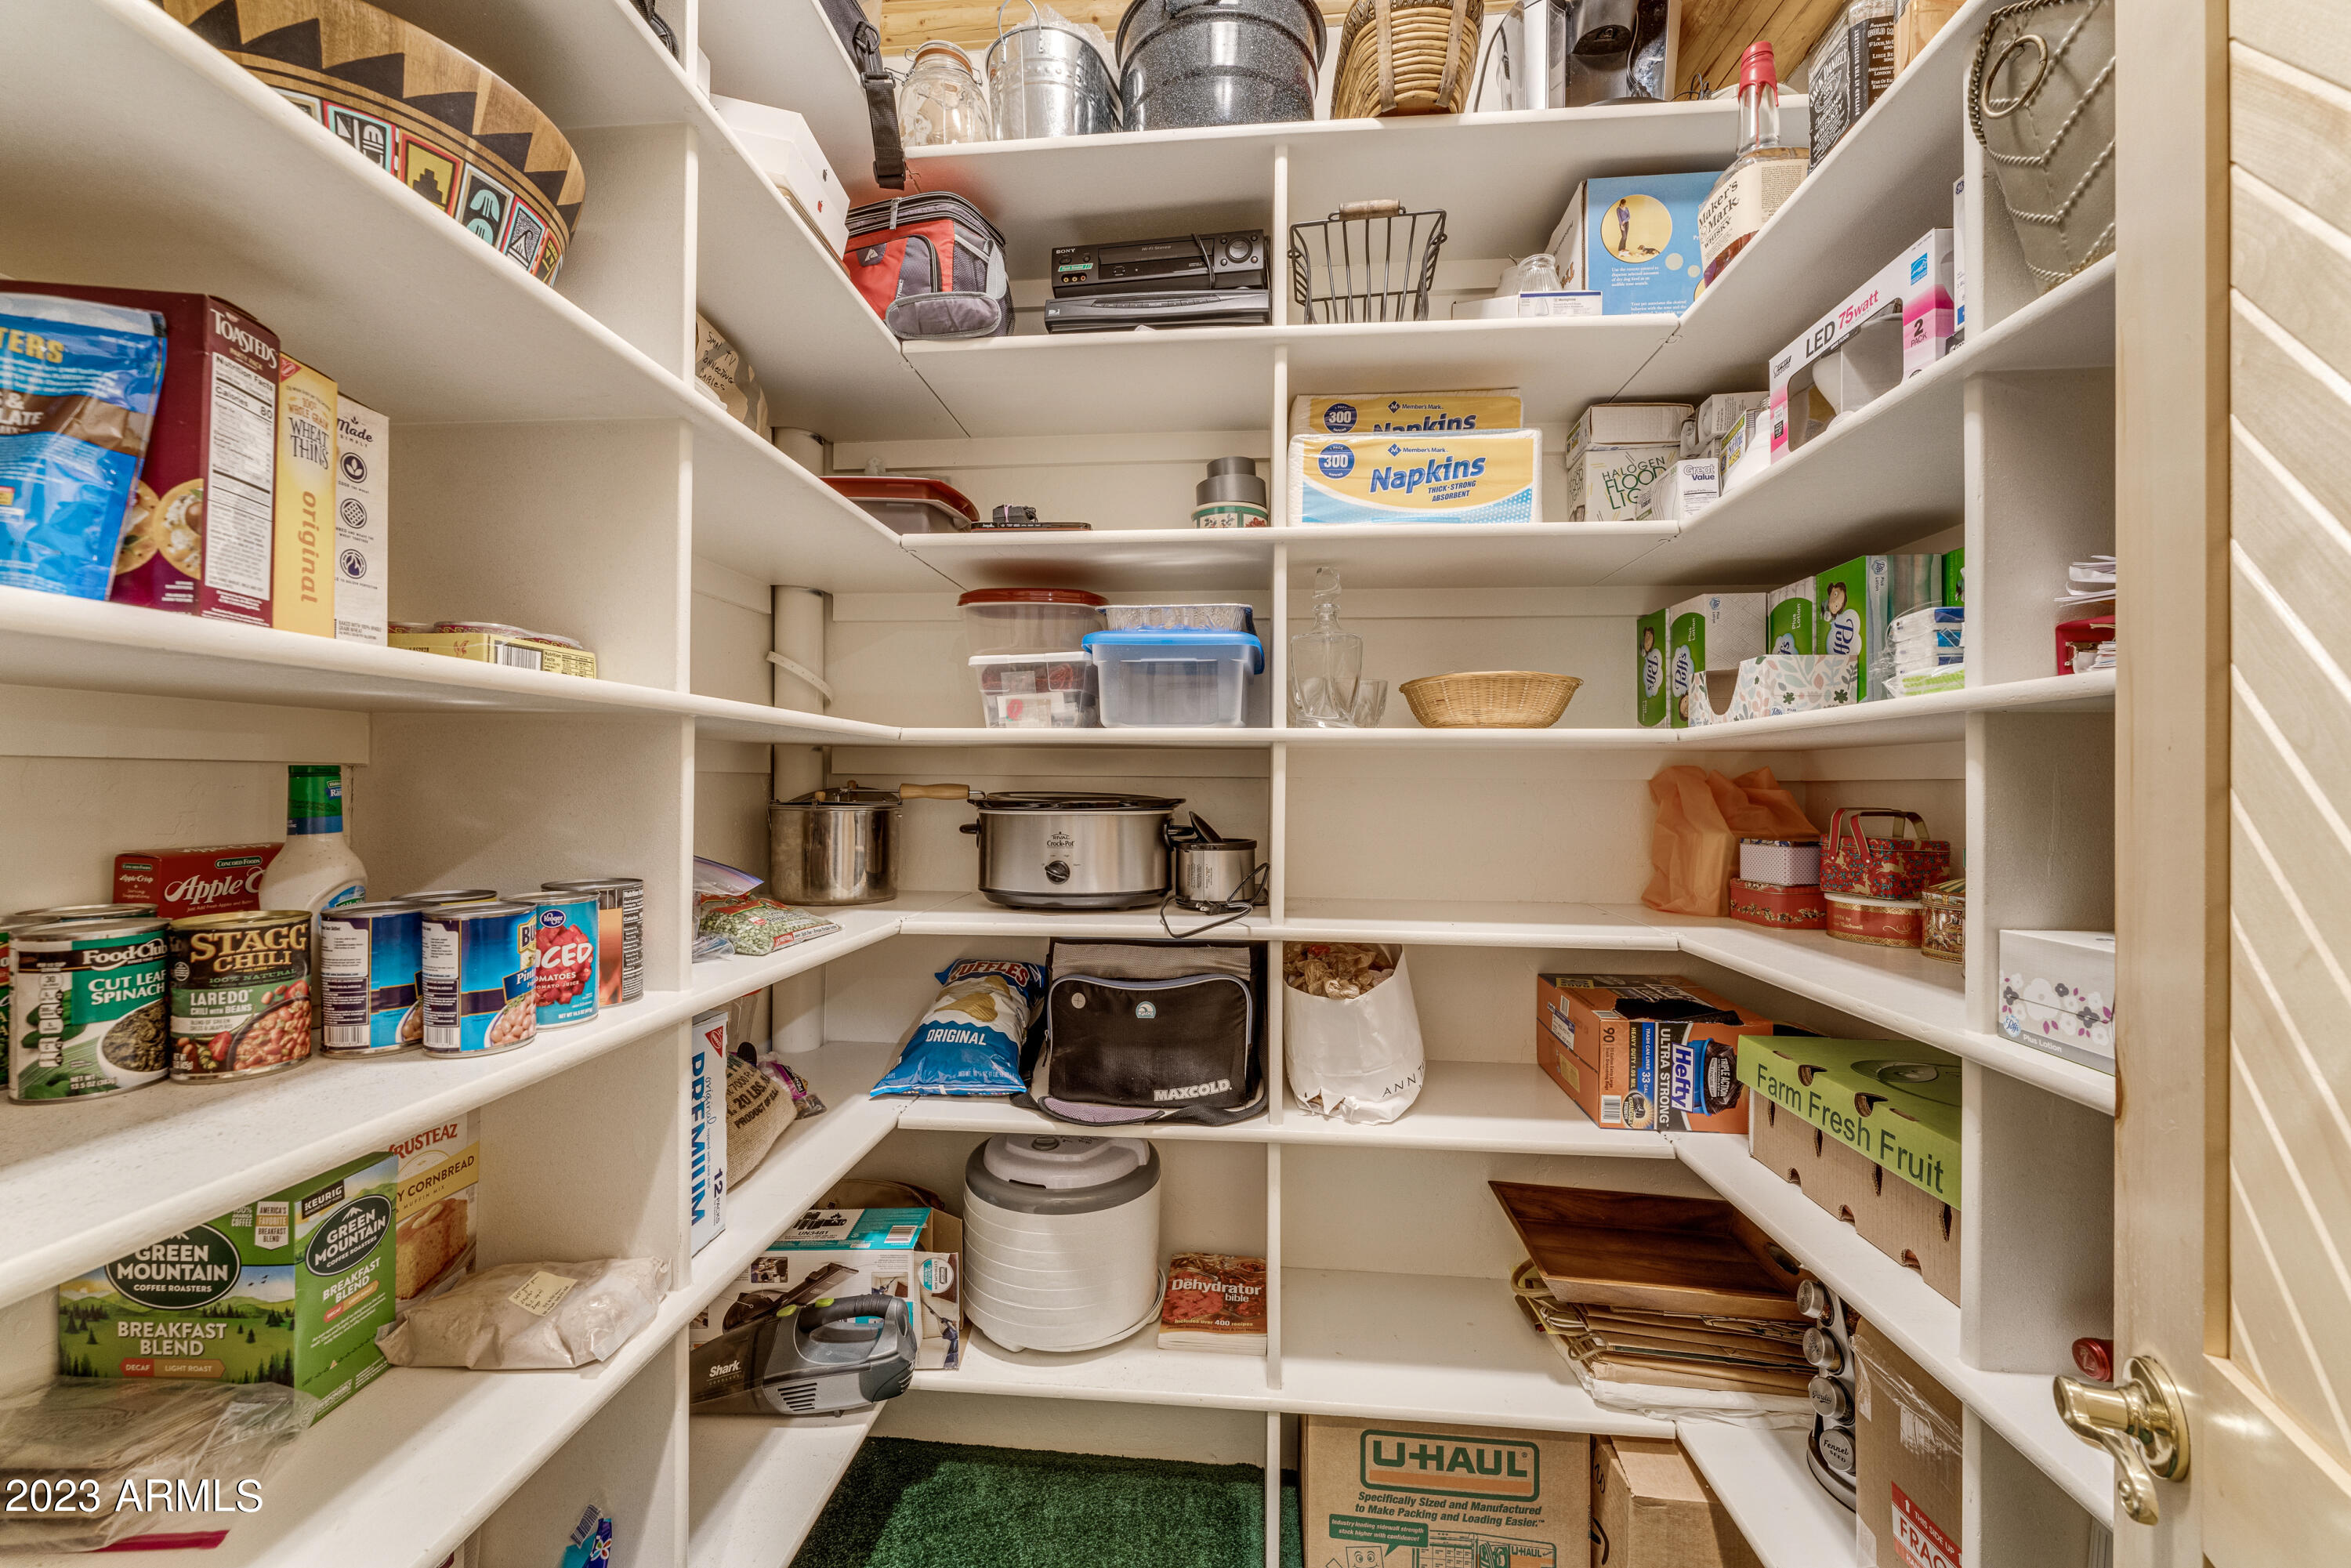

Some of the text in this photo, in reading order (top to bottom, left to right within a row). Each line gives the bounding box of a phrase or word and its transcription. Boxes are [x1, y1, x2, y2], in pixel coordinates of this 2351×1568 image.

[1867, 28, 1885, 38] GOLD
[1814, 100, 1843, 143] WHISKEY
[1699, 181, 1738, 230] Maker's
[1708, 197, 1739, 234] Mark
[1704, 216, 1732, 248] WHISKY
[1913, 317, 1924, 337] 2
[210, 308, 278, 369] TOASTEDS
[1806, 321, 1835, 359] LED
[1911, 331, 1928, 347] PACK
[216, 386, 249, 407] Calories
[1401, 402, 1427, 411] Member's
[260, 405, 273, 419] 80
[1328, 411, 1351, 423] 300
[1373, 413, 1476, 432] Napkins
[288, 417, 330, 448] WHEAT
[337, 418, 374, 443] Made
[1324, 456, 1349, 469] 300
[1603, 457, 1665, 480] HALOGEN
[1684, 465, 1715, 475] Great
[1369, 456, 1487, 494] Napkins
[1692, 473, 1715, 481] Value
[1428, 480, 1476, 494] THICK STRONG
[1432, 491, 1470, 502] ABSORBENT
[297, 491, 320, 603] original
[1646, 655, 1659, 690] Puffs
[1675, 652, 1689, 690] Puffs
[119, 874, 154, 884] Apple Crisp
[164, 875, 244, 905] Apple
[624, 889, 638, 898] Nutrition
[543, 912, 563, 925] Kroger
[82, 938, 168, 966] Food Club
[190, 923, 308, 963] STAGG
[213, 951, 292, 973] CHILI
[88, 969, 167, 992] CUT LEAF
[243, 969, 296, 981] NATURAL
[91, 981, 165, 1005] SPINACH
[190, 989, 249, 1006] LAREDO
[190, 1004, 252, 1016] CHILI BEANS
[926, 1029, 987, 1045] ORIGINAL
[1603, 1027, 1615, 1043] 90
[2023, 1034, 2063, 1052] Plus Lotion
[1382, 1073, 1416, 1098] ANN
[1642, 1071, 1651, 1084] 33
[1659, 1028, 1671, 1124] ULTRA STRONG
[1672, 1048, 1691, 1108] Hefty
[1720, 1058, 1730, 1097] TRIPLE ACTION
[705, 1077, 717, 1125] original
[734, 1092, 752, 1110] 20
[1154, 1079, 1230, 1102] MAXCOLD
[734, 1103, 766, 1129] PRODUCT
[1757, 1063, 1943, 1194] Farm Fresh Fruit
[408, 1156, 475, 1197] CORNBREAD
[714, 1168, 723, 1199] 12
[304, 1185, 343, 1211] KEURIG
[403, 1185, 445, 1211] MUFFIN MIX
[231, 1218, 252, 1227] COFFEE
[259, 1217, 287, 1226] FAVORITE
[326, 1208, 376, 1244] GREEN
[314, 1215, 387, 1266] MOUNTAIN
[134, 1244, 209, 1262] GREEN
[326, 1235, 378, 1269] COFFEE ROASTERS
[117, 1263, 229, 1281] MOUNTAIN
[322, 1257, 382, 1302] BREAKFAST
[168, 1284, 212, 1293] ROASTERS
[335, 1275, 370, 1304] BLEND
[1172, 1278, 1262, 1295] Dehydrator
[1225, 1294, 1249, 1302] bible
[118, 1321, 227, 1340] BREAKFAST
[139, 1339, 205, 1356] BLEND
[709, 1360, 741, 1378] Shark
[1812, 1390, 1833, 1404] Parsley
[1823, 1439, 1849, 1456] Fennel
[1830, 1450, 1847, 1463] SEED
[1372, 1440, 1528, 1478] U-HAUL
[1358, 1491, 1416, 1507] Specifically
[1449, 1499, 1469, 1510] and
[1470, 1501, 1541, 1515] Manufactured
[1355, 1503, 1503, 1527] to Make Packing and Loading
[1332, 1519, 1424, 1534] Industry leading sidewall strength
[1355, 1530, 1373, 1538] higher
[1386, 1534, 1420, 1542] confidence!
[1914, 1510, 1954, 1555] THIS SIDE UP
[1511, 1546, 1541, 1558] U-HAUL
